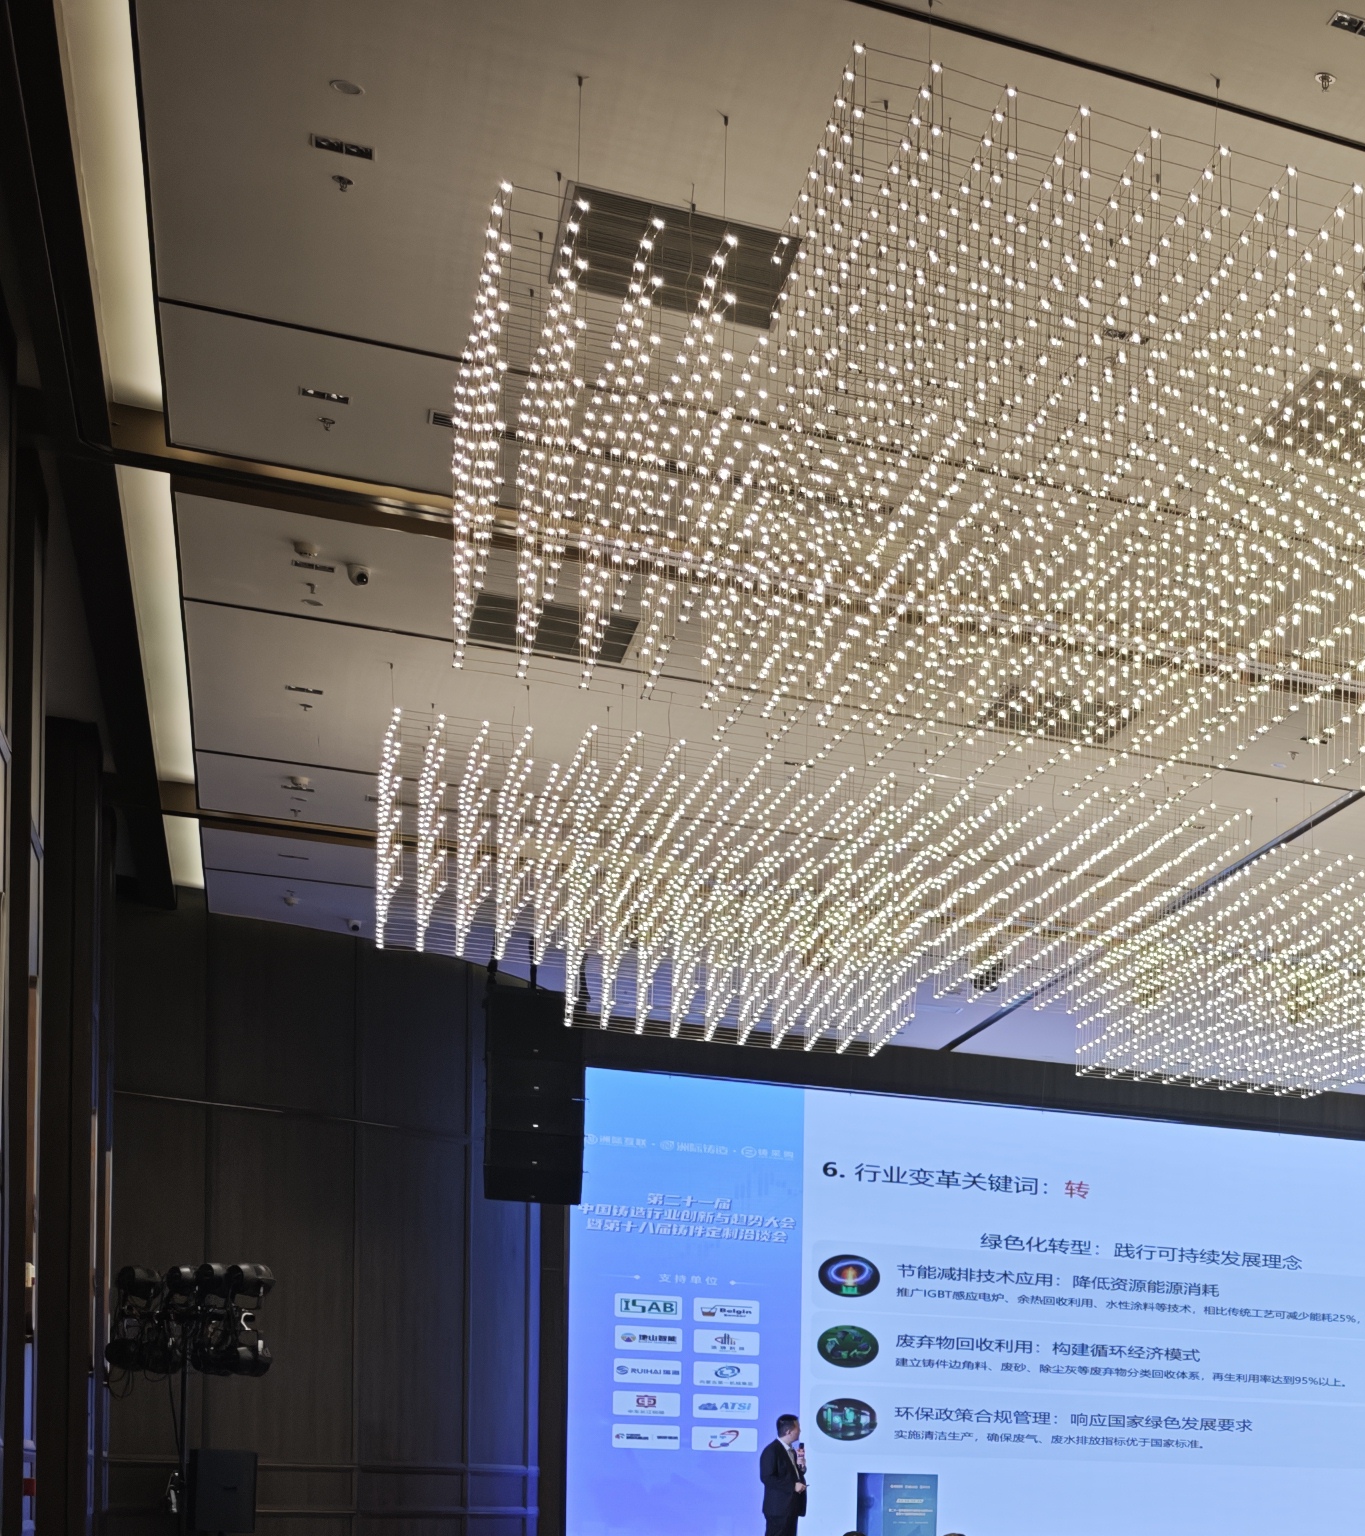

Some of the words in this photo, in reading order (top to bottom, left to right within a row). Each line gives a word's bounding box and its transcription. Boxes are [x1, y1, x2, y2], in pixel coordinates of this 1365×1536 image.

[822, 1161, 845, 1179] 6.
[647, 1192, 733, 1211] 第二十一届
[578, 1203, 797, 1230] 中国铸造行业创新与趋势大会
[586, 1218, 789, 1245] 暨第十八届铸件定制洽谈会
[979, 1233, 1303, 1271] 绿色化转型：践行可持续发展理念
[658, 1272, 718, 1286] 支持单位
[896, 1263, 1220, 1298] 节能减排技术应用：降低资源能源消耗
[621, 1298, 678, 1315] ISAB
[895, 1334, 1201, 1363] 废弃物回收利用：构建循环经济模式
[895, 1357, 1346, 1387] 建立铸件边角料、废砂、除尘灰等废弃物分类回收体系，再生利用率达到95%以上。
[894, 1406, 1253, 1433] 环保政策合规管理：响应国家绿色发展要求
[893, 1429, 1204, 1449] 实施清洁生产，确保废气、废水排放指标优于国家标准。
